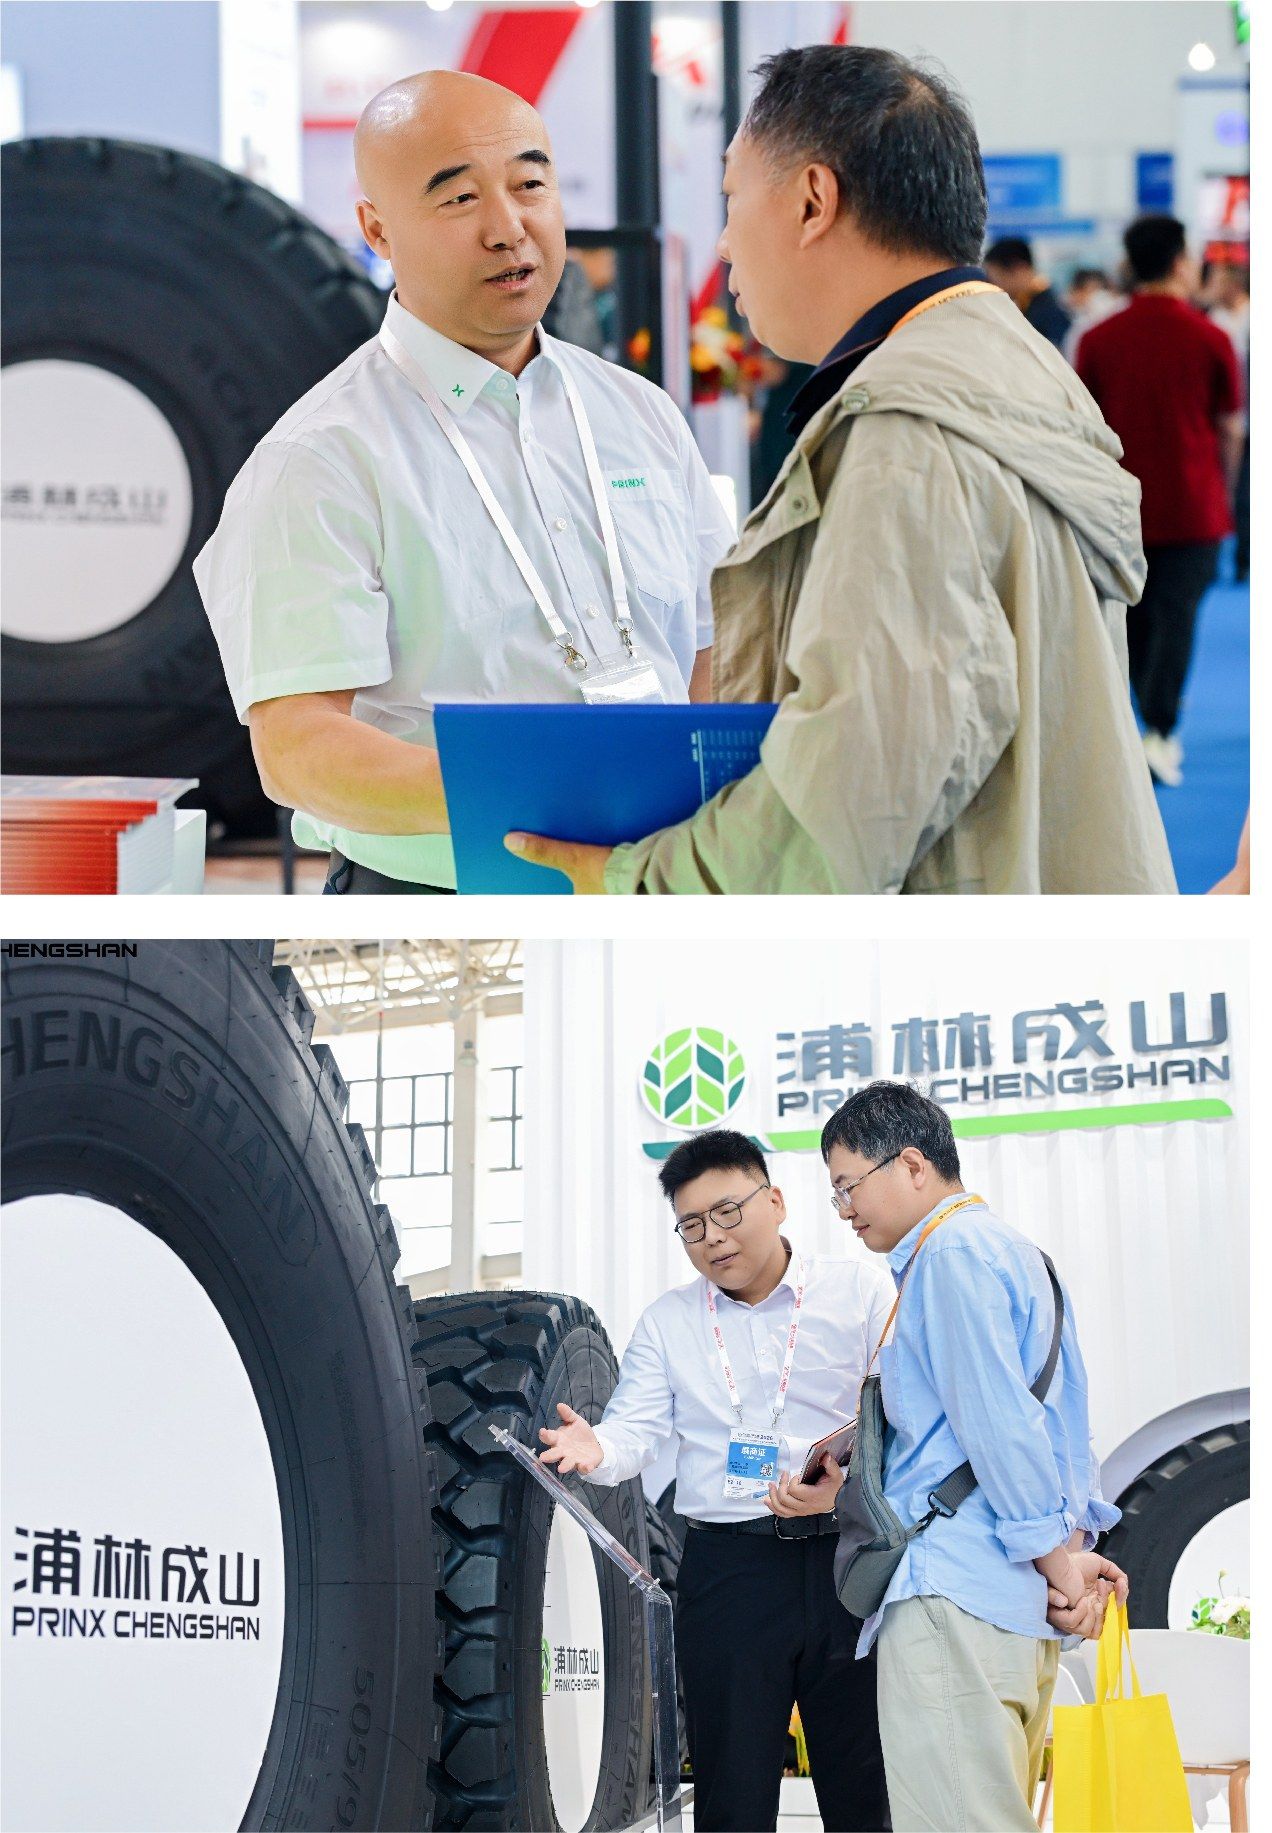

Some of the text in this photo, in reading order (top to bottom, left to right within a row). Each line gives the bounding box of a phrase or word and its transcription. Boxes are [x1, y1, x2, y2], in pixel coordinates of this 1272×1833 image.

[611, 477, 646, 489] PRINX
[776, 992, 1229, 1084] 浦林成山
[931, 1055, 1231, 1105] CHENGSHAN
[14, 1526, 260, 1607] 浦林成山
[12, 1606, 260, 1641] PRINX CHENGSHAN
[554, 1646, 599, 1675] 浦林成山
[621, 1526, 643, 1823] CENGSHAN
[331, 1666, 376, 1832] 505/9
